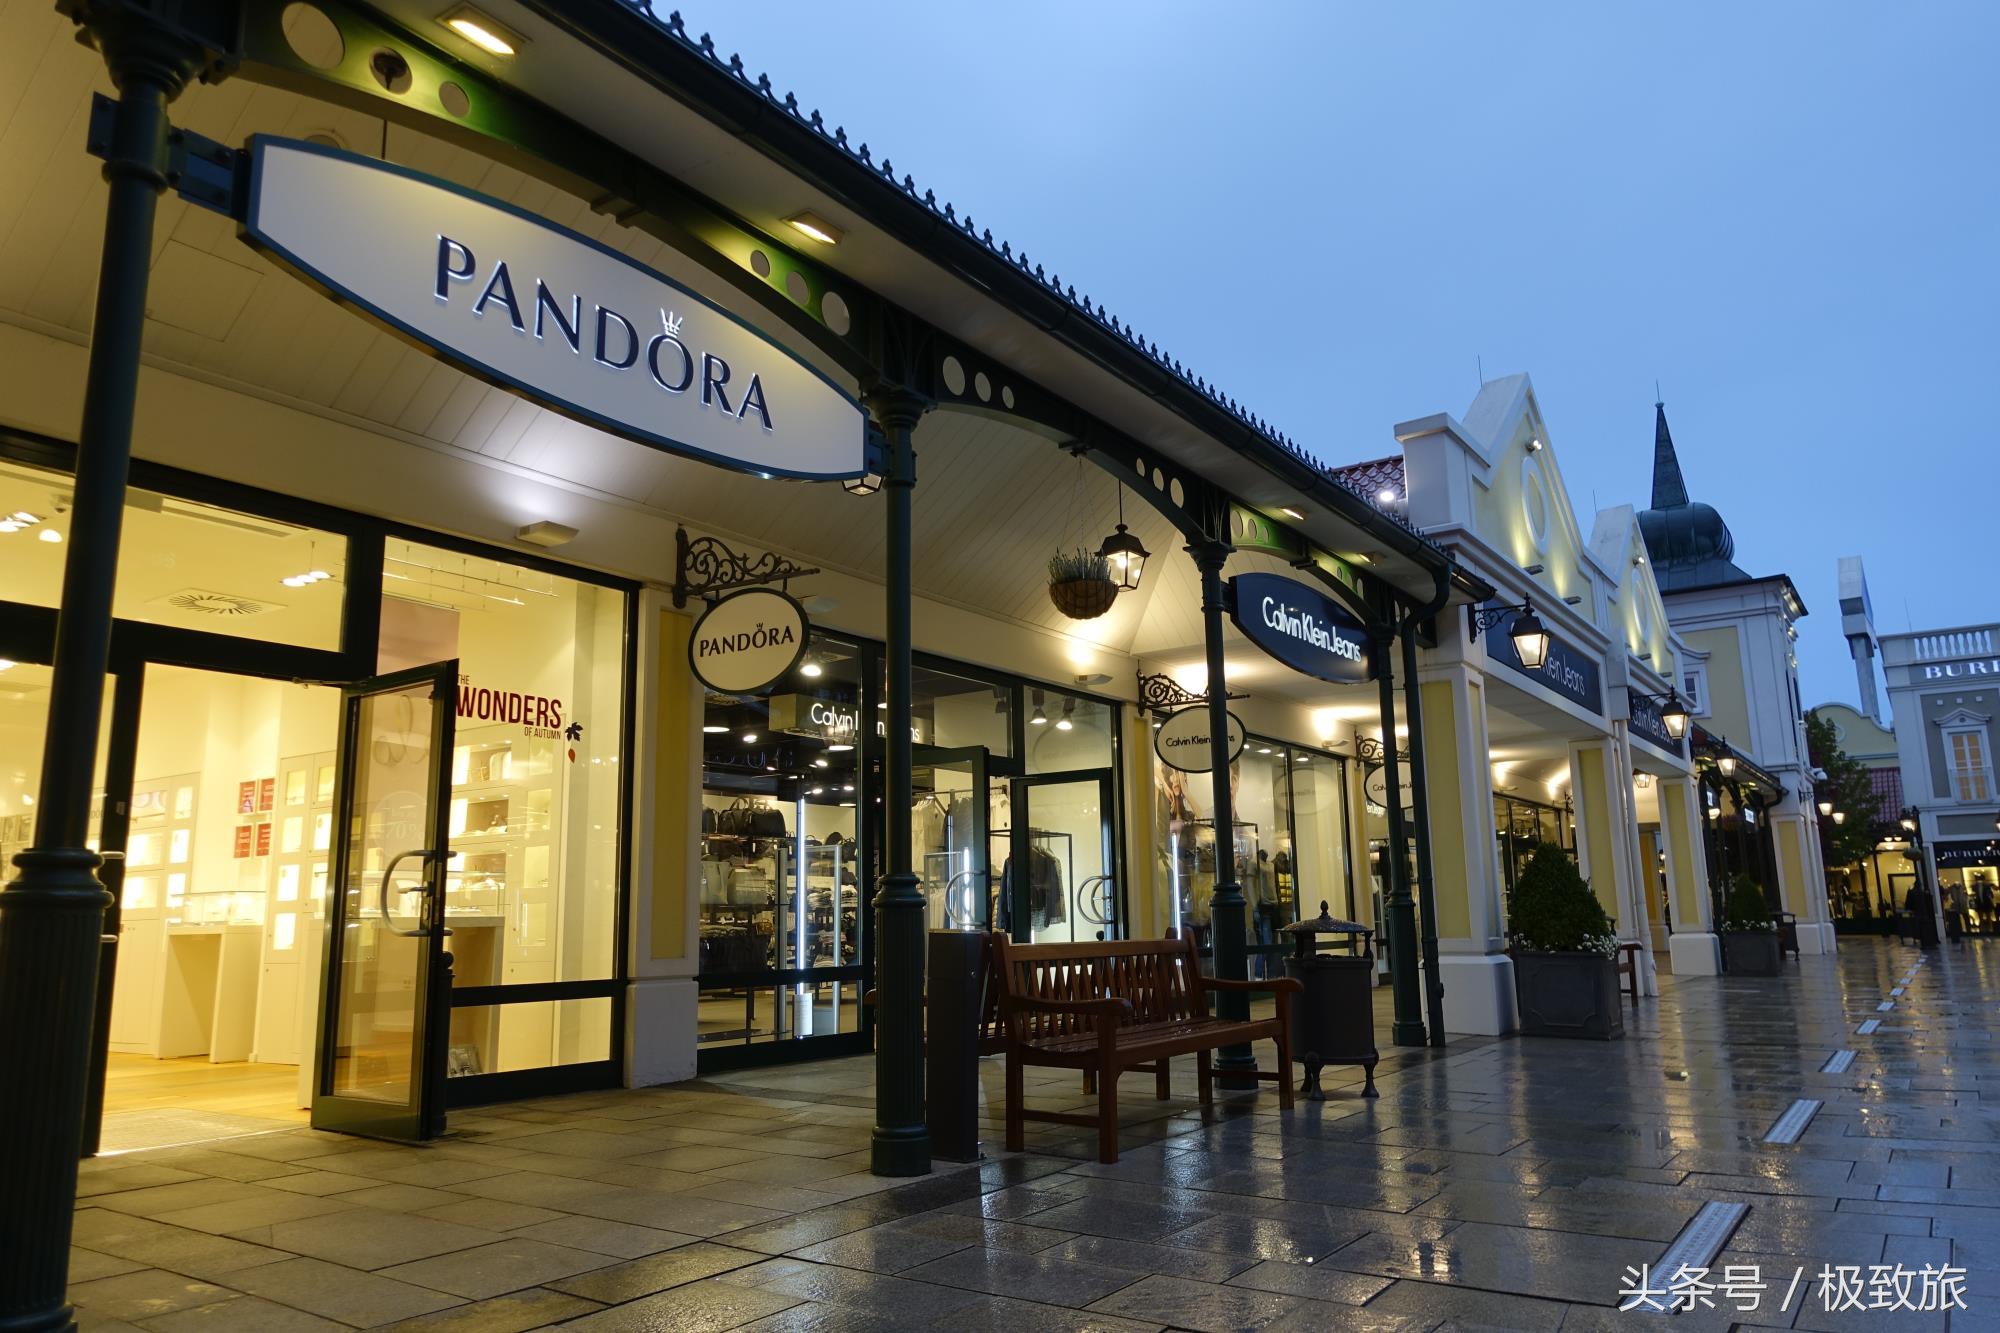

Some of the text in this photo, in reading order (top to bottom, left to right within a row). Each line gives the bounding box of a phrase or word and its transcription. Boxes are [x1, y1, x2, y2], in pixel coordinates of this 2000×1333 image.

[433, 233, 774, 432] PANDORA
[699, 625, 795, 658] PANDORA
[1262, 596, 1362, 663] Calvin Klein Jeans
[456, 685, 562, 729] WONDERS
[811, 702, 854, 730] Calvin
[524, 726, 562, 740] OF AUTUMN
[1165, 734, 1211, 748] Calvin Klein
